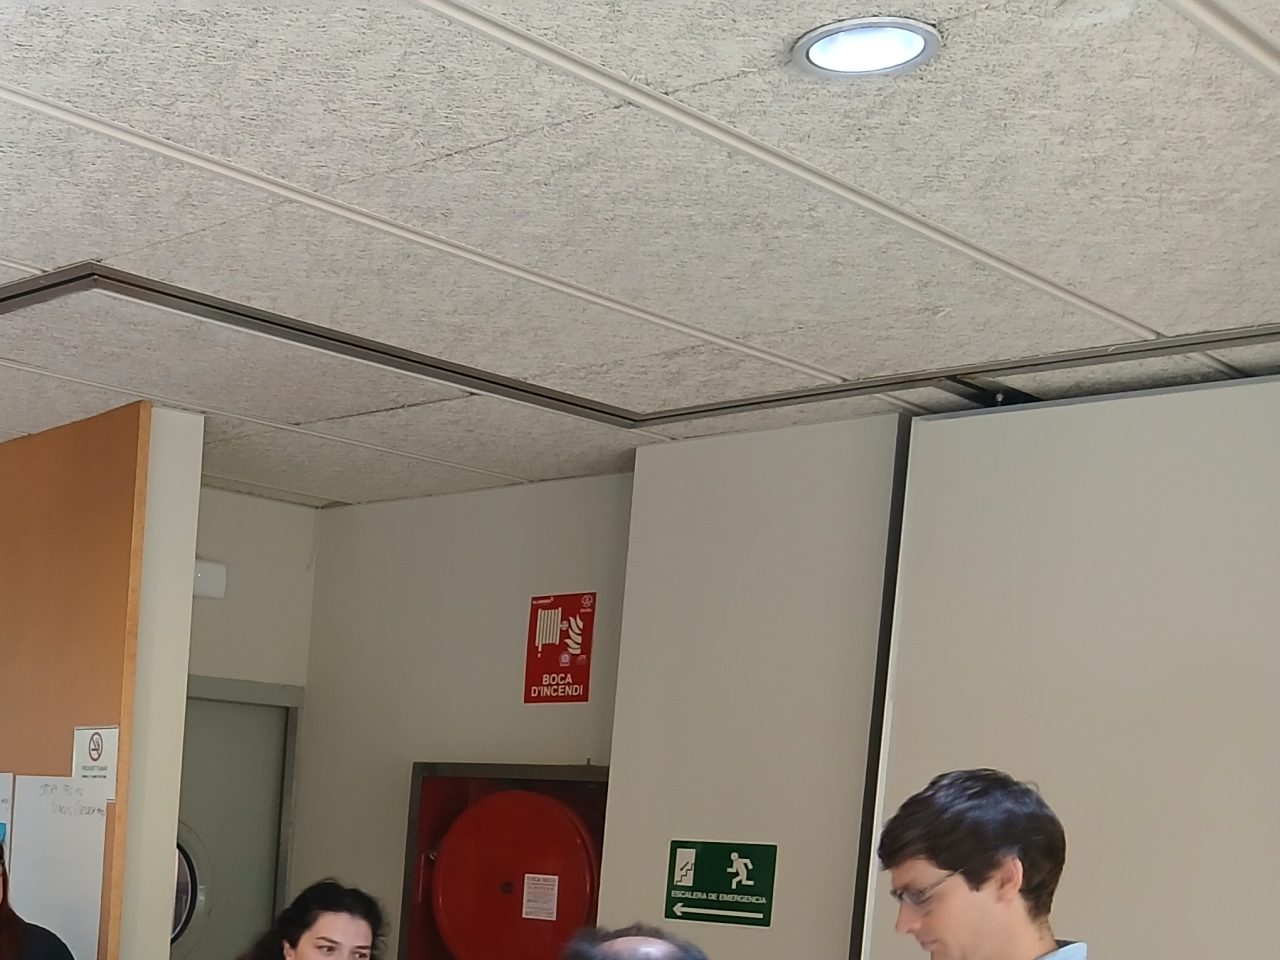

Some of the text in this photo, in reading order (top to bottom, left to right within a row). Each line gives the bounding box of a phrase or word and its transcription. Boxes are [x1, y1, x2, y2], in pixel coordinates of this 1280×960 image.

[542, 673, 572, 685] BOCA
[531, 685, 583, 697] D'INCENDI
[671, 890, 767, 904] ESCALERA DE EMERGENCIA
